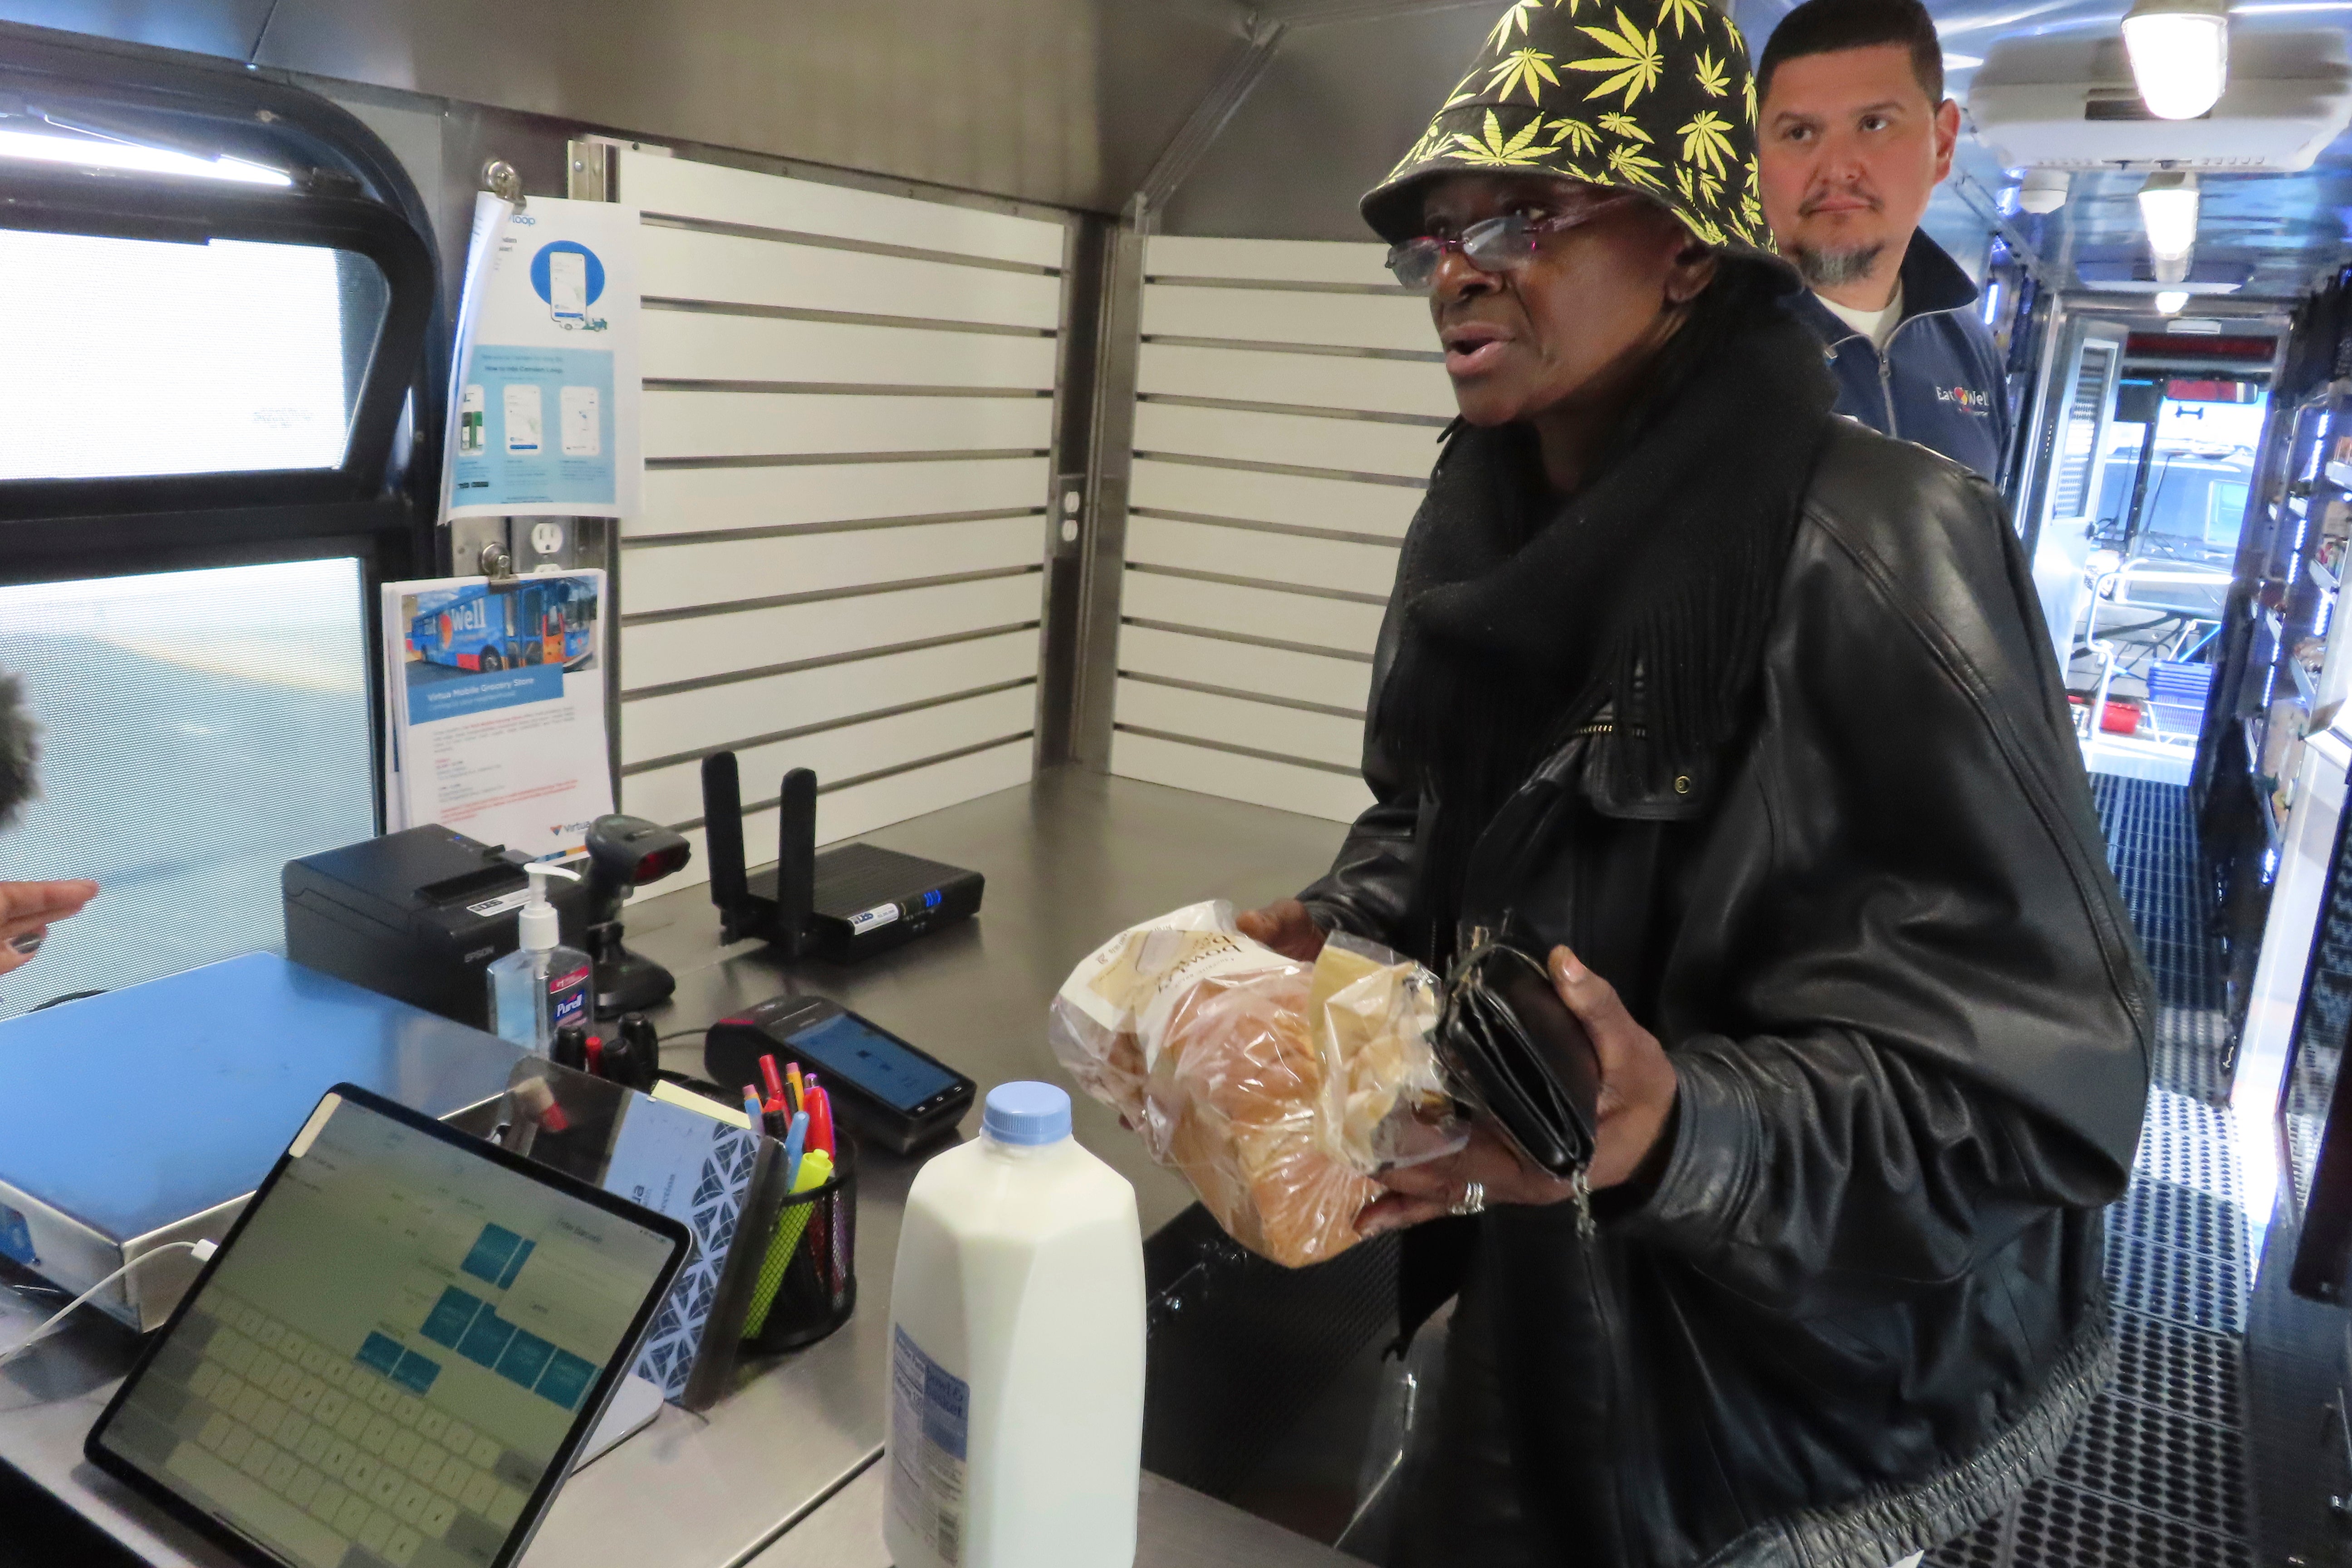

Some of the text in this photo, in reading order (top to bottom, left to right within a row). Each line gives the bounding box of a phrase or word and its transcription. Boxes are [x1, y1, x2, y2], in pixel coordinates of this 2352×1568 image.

[1936, 386, 1955, 401] Eat
[451, 598, 486, 631] Well
[464, 946, 495, 963] EPSON
[557, 994, 583, 1017] Purell
